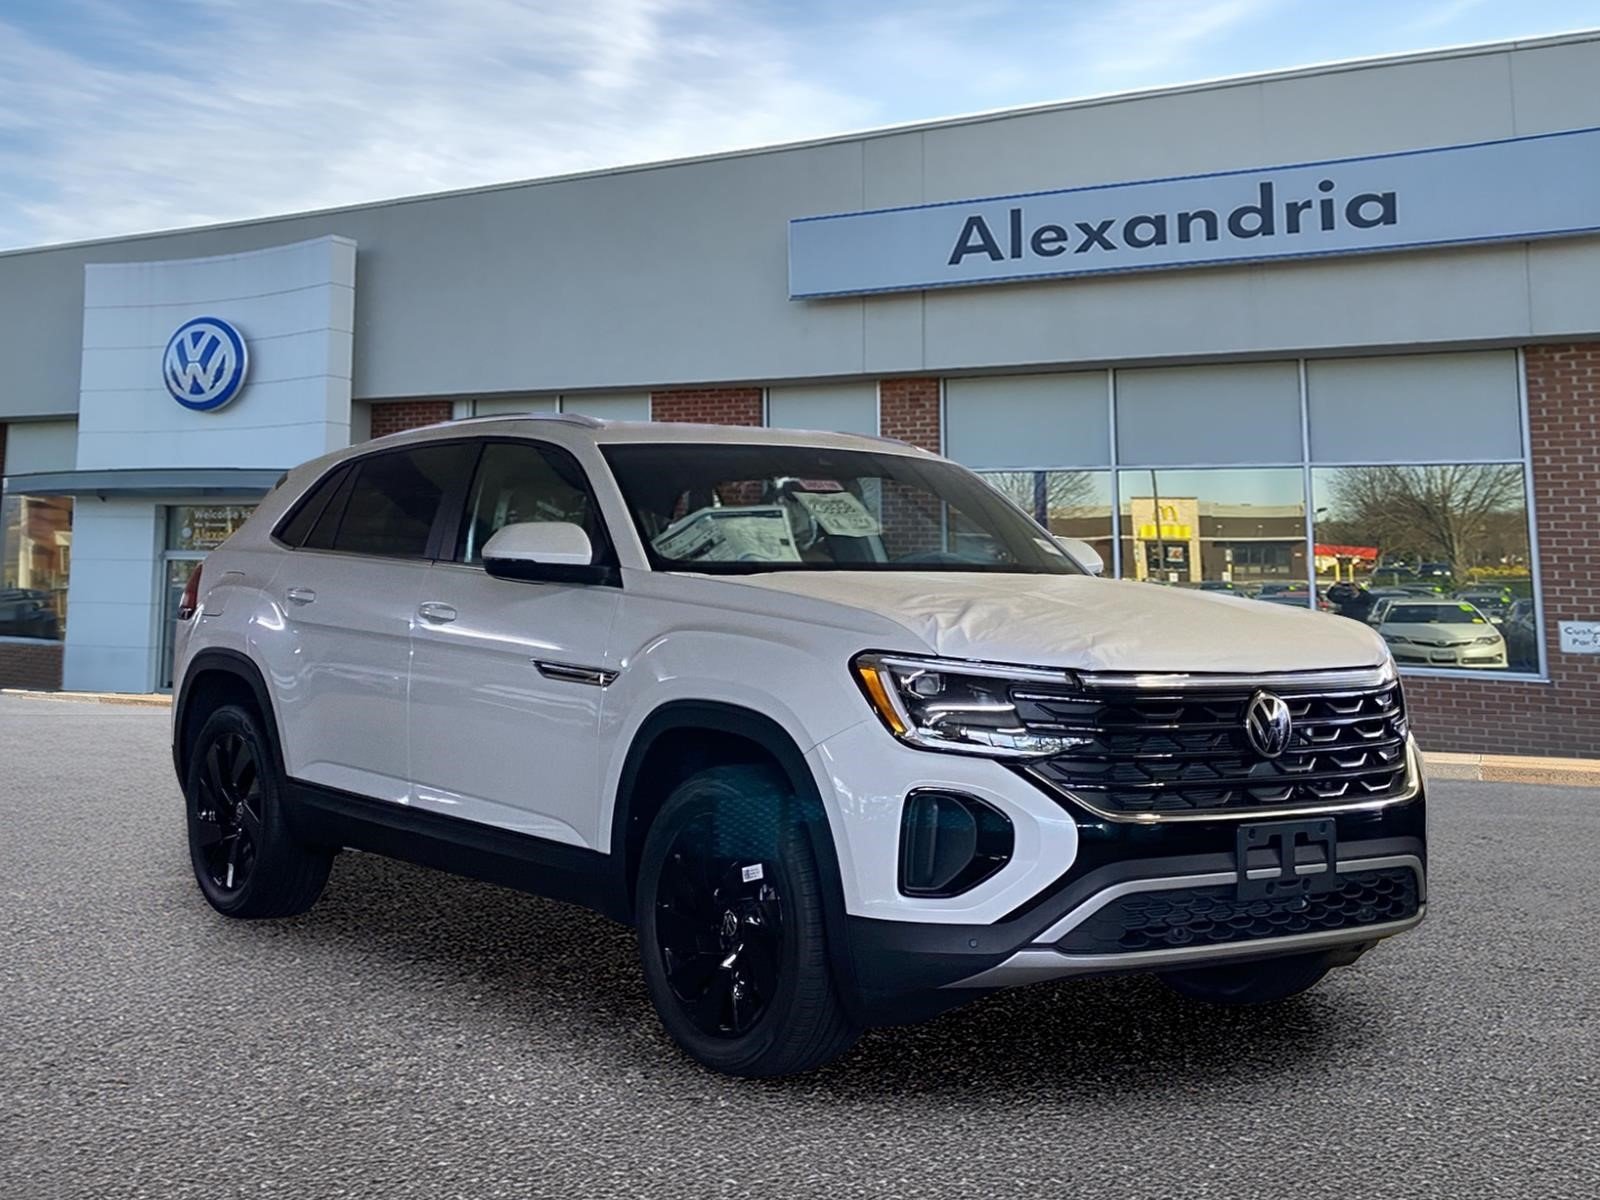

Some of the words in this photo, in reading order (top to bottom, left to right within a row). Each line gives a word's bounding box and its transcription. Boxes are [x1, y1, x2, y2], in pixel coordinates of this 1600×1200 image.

[948, 179, 1398, 266] Alexandria
[167, 324, 238, 403] VW
[1248, 691, 1291, 756] VW
